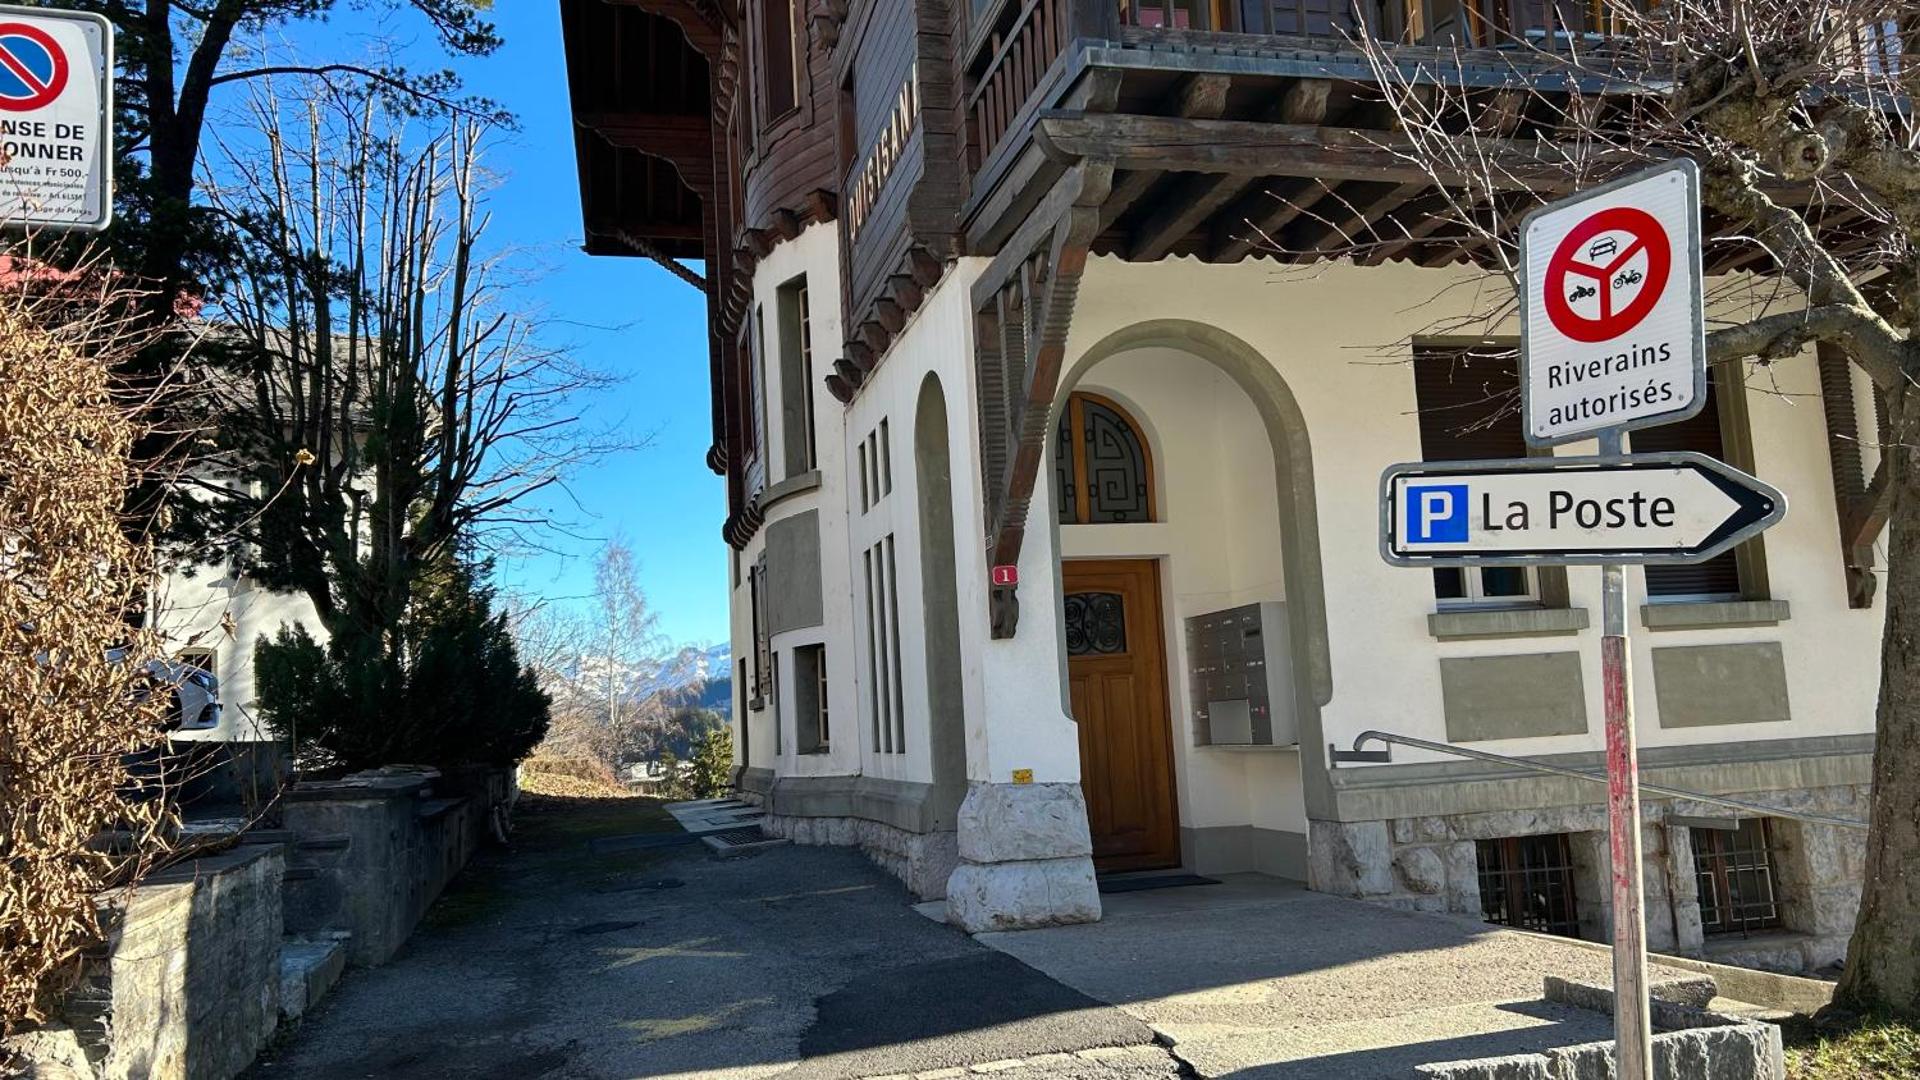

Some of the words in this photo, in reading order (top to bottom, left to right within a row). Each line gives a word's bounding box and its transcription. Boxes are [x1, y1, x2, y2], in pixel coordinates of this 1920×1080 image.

[56, 123, 84, 141] DE
[1548, 341, 1671, 389] Riverains
[1549, 379, 1673, 425] autorisés
[1420, 490, 1453, 539] P
[1482, 492, 1529, 532] La
[1549, 490, 1676, 529] Poste
[1002, 569, 1010, 582] 1
